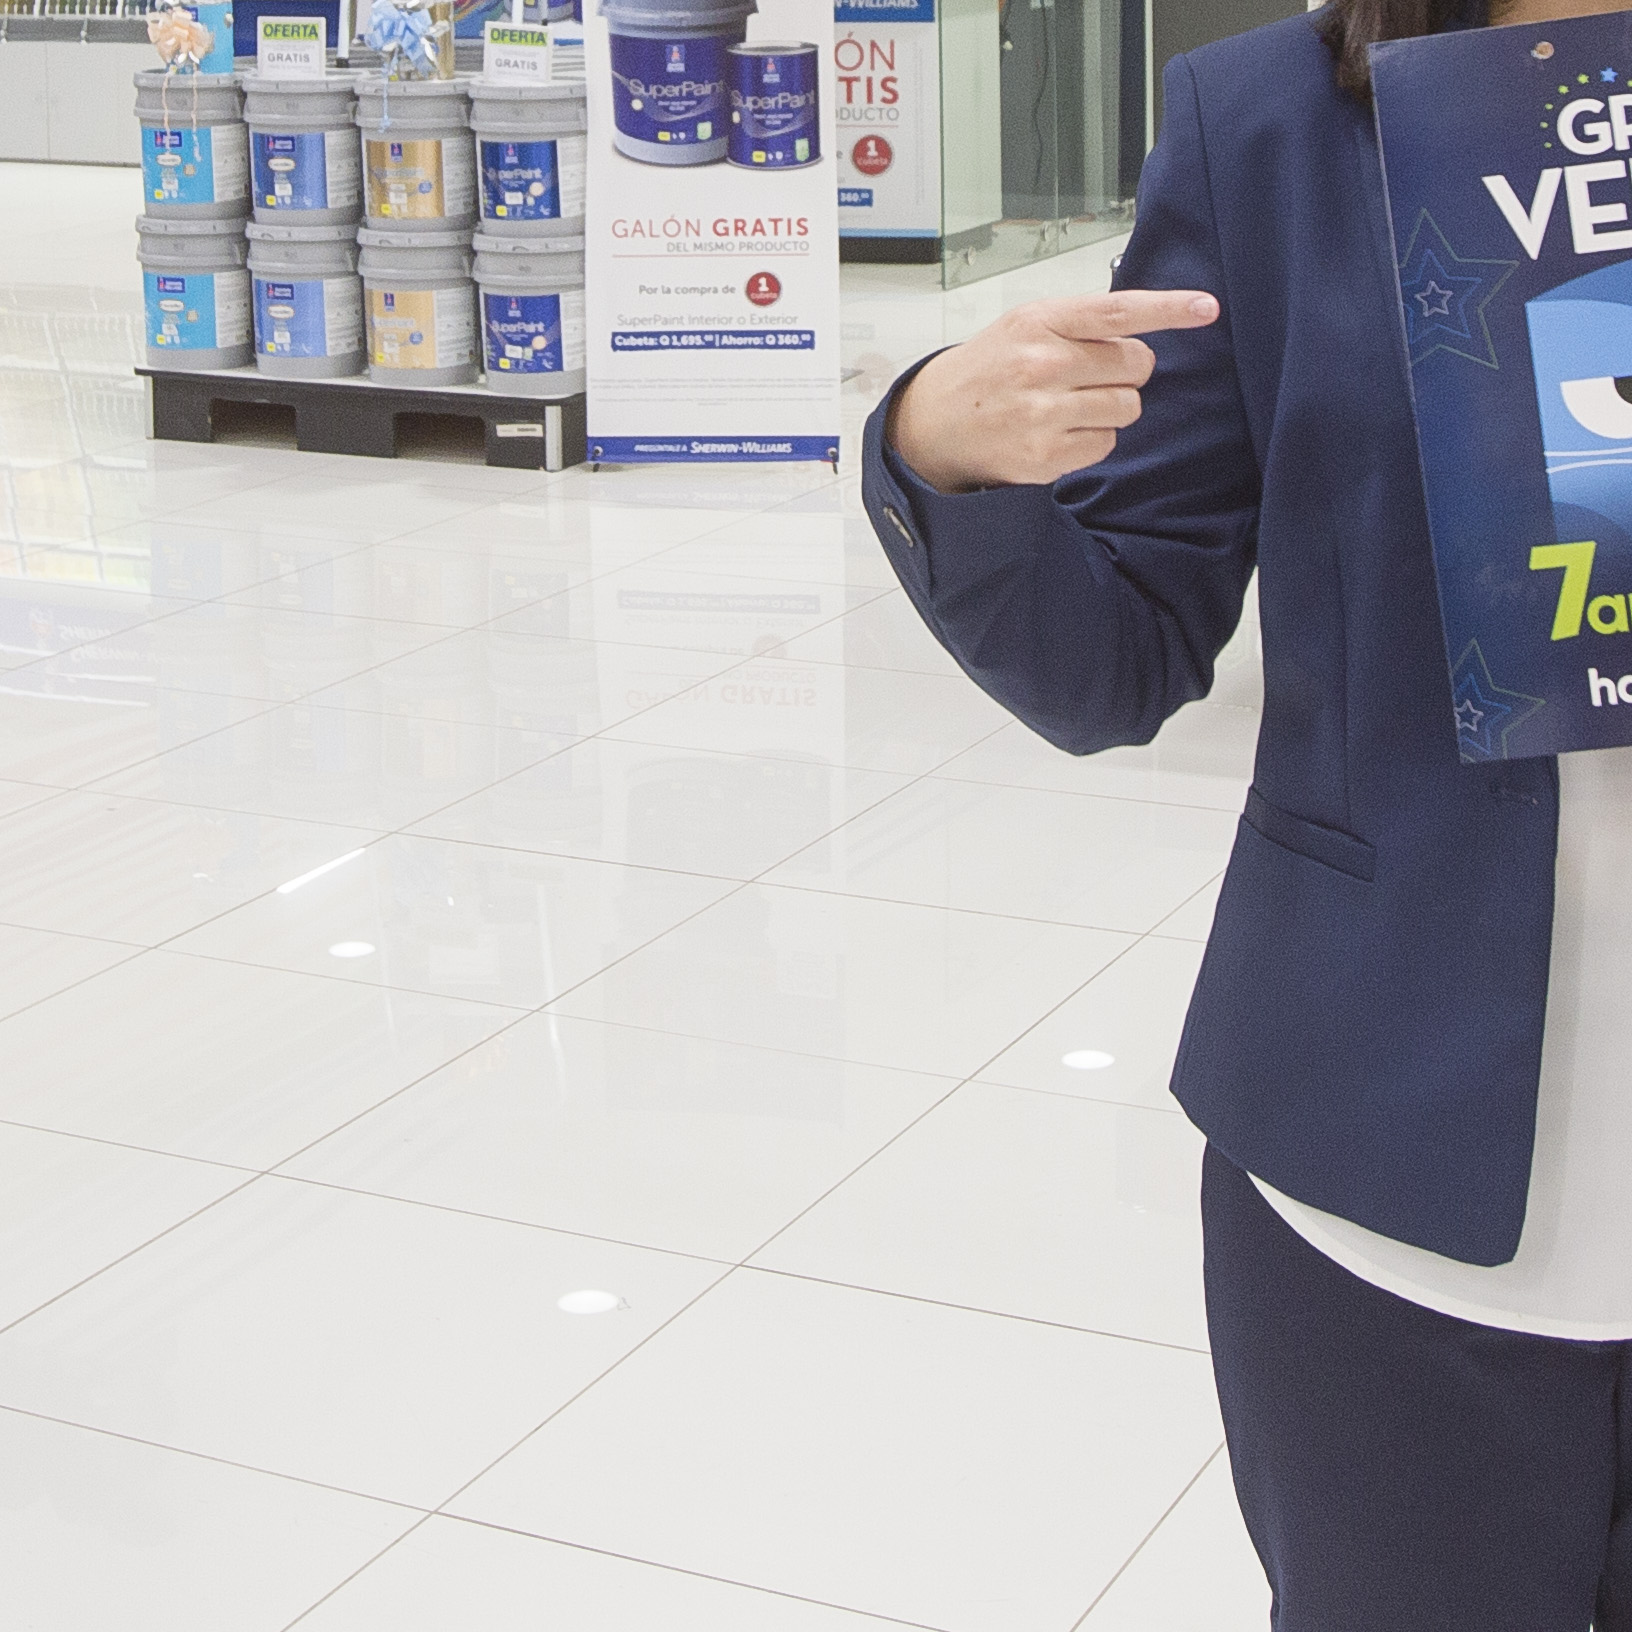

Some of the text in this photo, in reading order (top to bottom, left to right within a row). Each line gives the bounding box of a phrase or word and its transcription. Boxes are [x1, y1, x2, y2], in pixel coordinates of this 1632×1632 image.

[263, 23, 319, 39] OFERTA
[490, 27, 546, 44] OFERTA
[268, 53, 310, 63] GRATIS
[834, 32, 895, 71] ÓN
[494, 58, 538, 70] GRATIS
[838, 76, 899, 104] TIS
[612, 215, 809, 239] GALÓN GRATIS
[667, 241, 809, 253] DEL MISMO PRODUCTO
[639, 277, 769, 297] Por la compra de 1
[617, 314, 798, 328] SuperPaint Interior o Exterior
[615, 335, 658, 346] Cubeta:
[660, 335, 669, 346] Q
[721, 334, 764, 345] Ahorro:
[766, 334, 776, 345] Q
